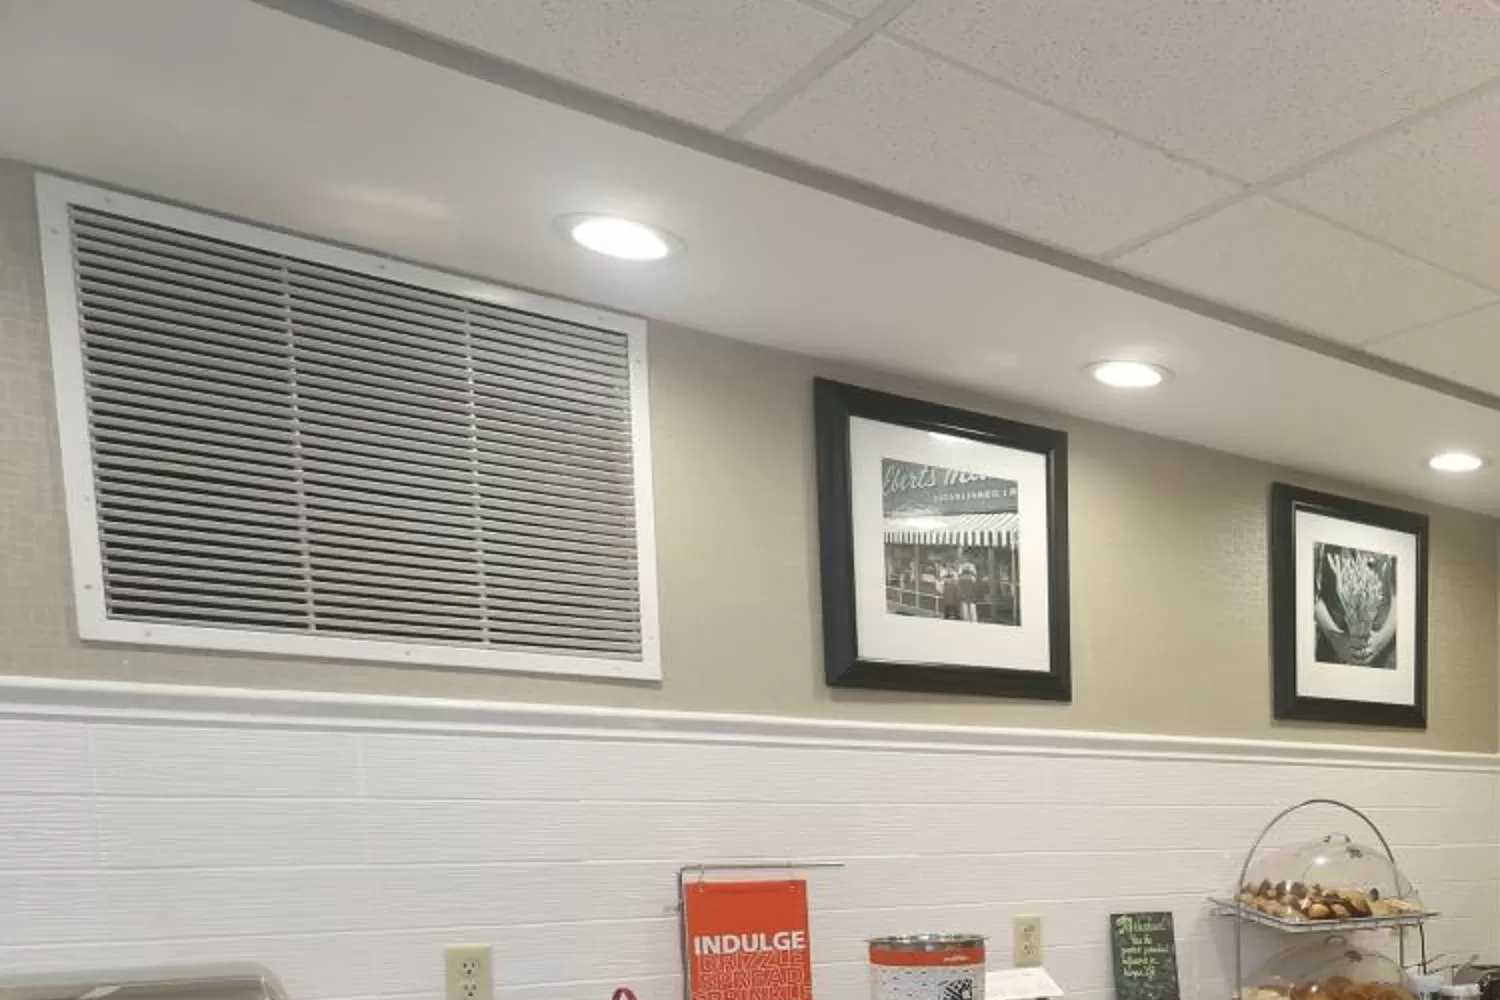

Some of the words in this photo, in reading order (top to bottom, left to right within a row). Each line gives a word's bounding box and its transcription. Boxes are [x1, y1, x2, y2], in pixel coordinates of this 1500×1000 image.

[693, 931, 806, 956] INDULGE
[702, 951, 805, 973] DRIZZLE
[700, 966, 805, 992] SPREAD
